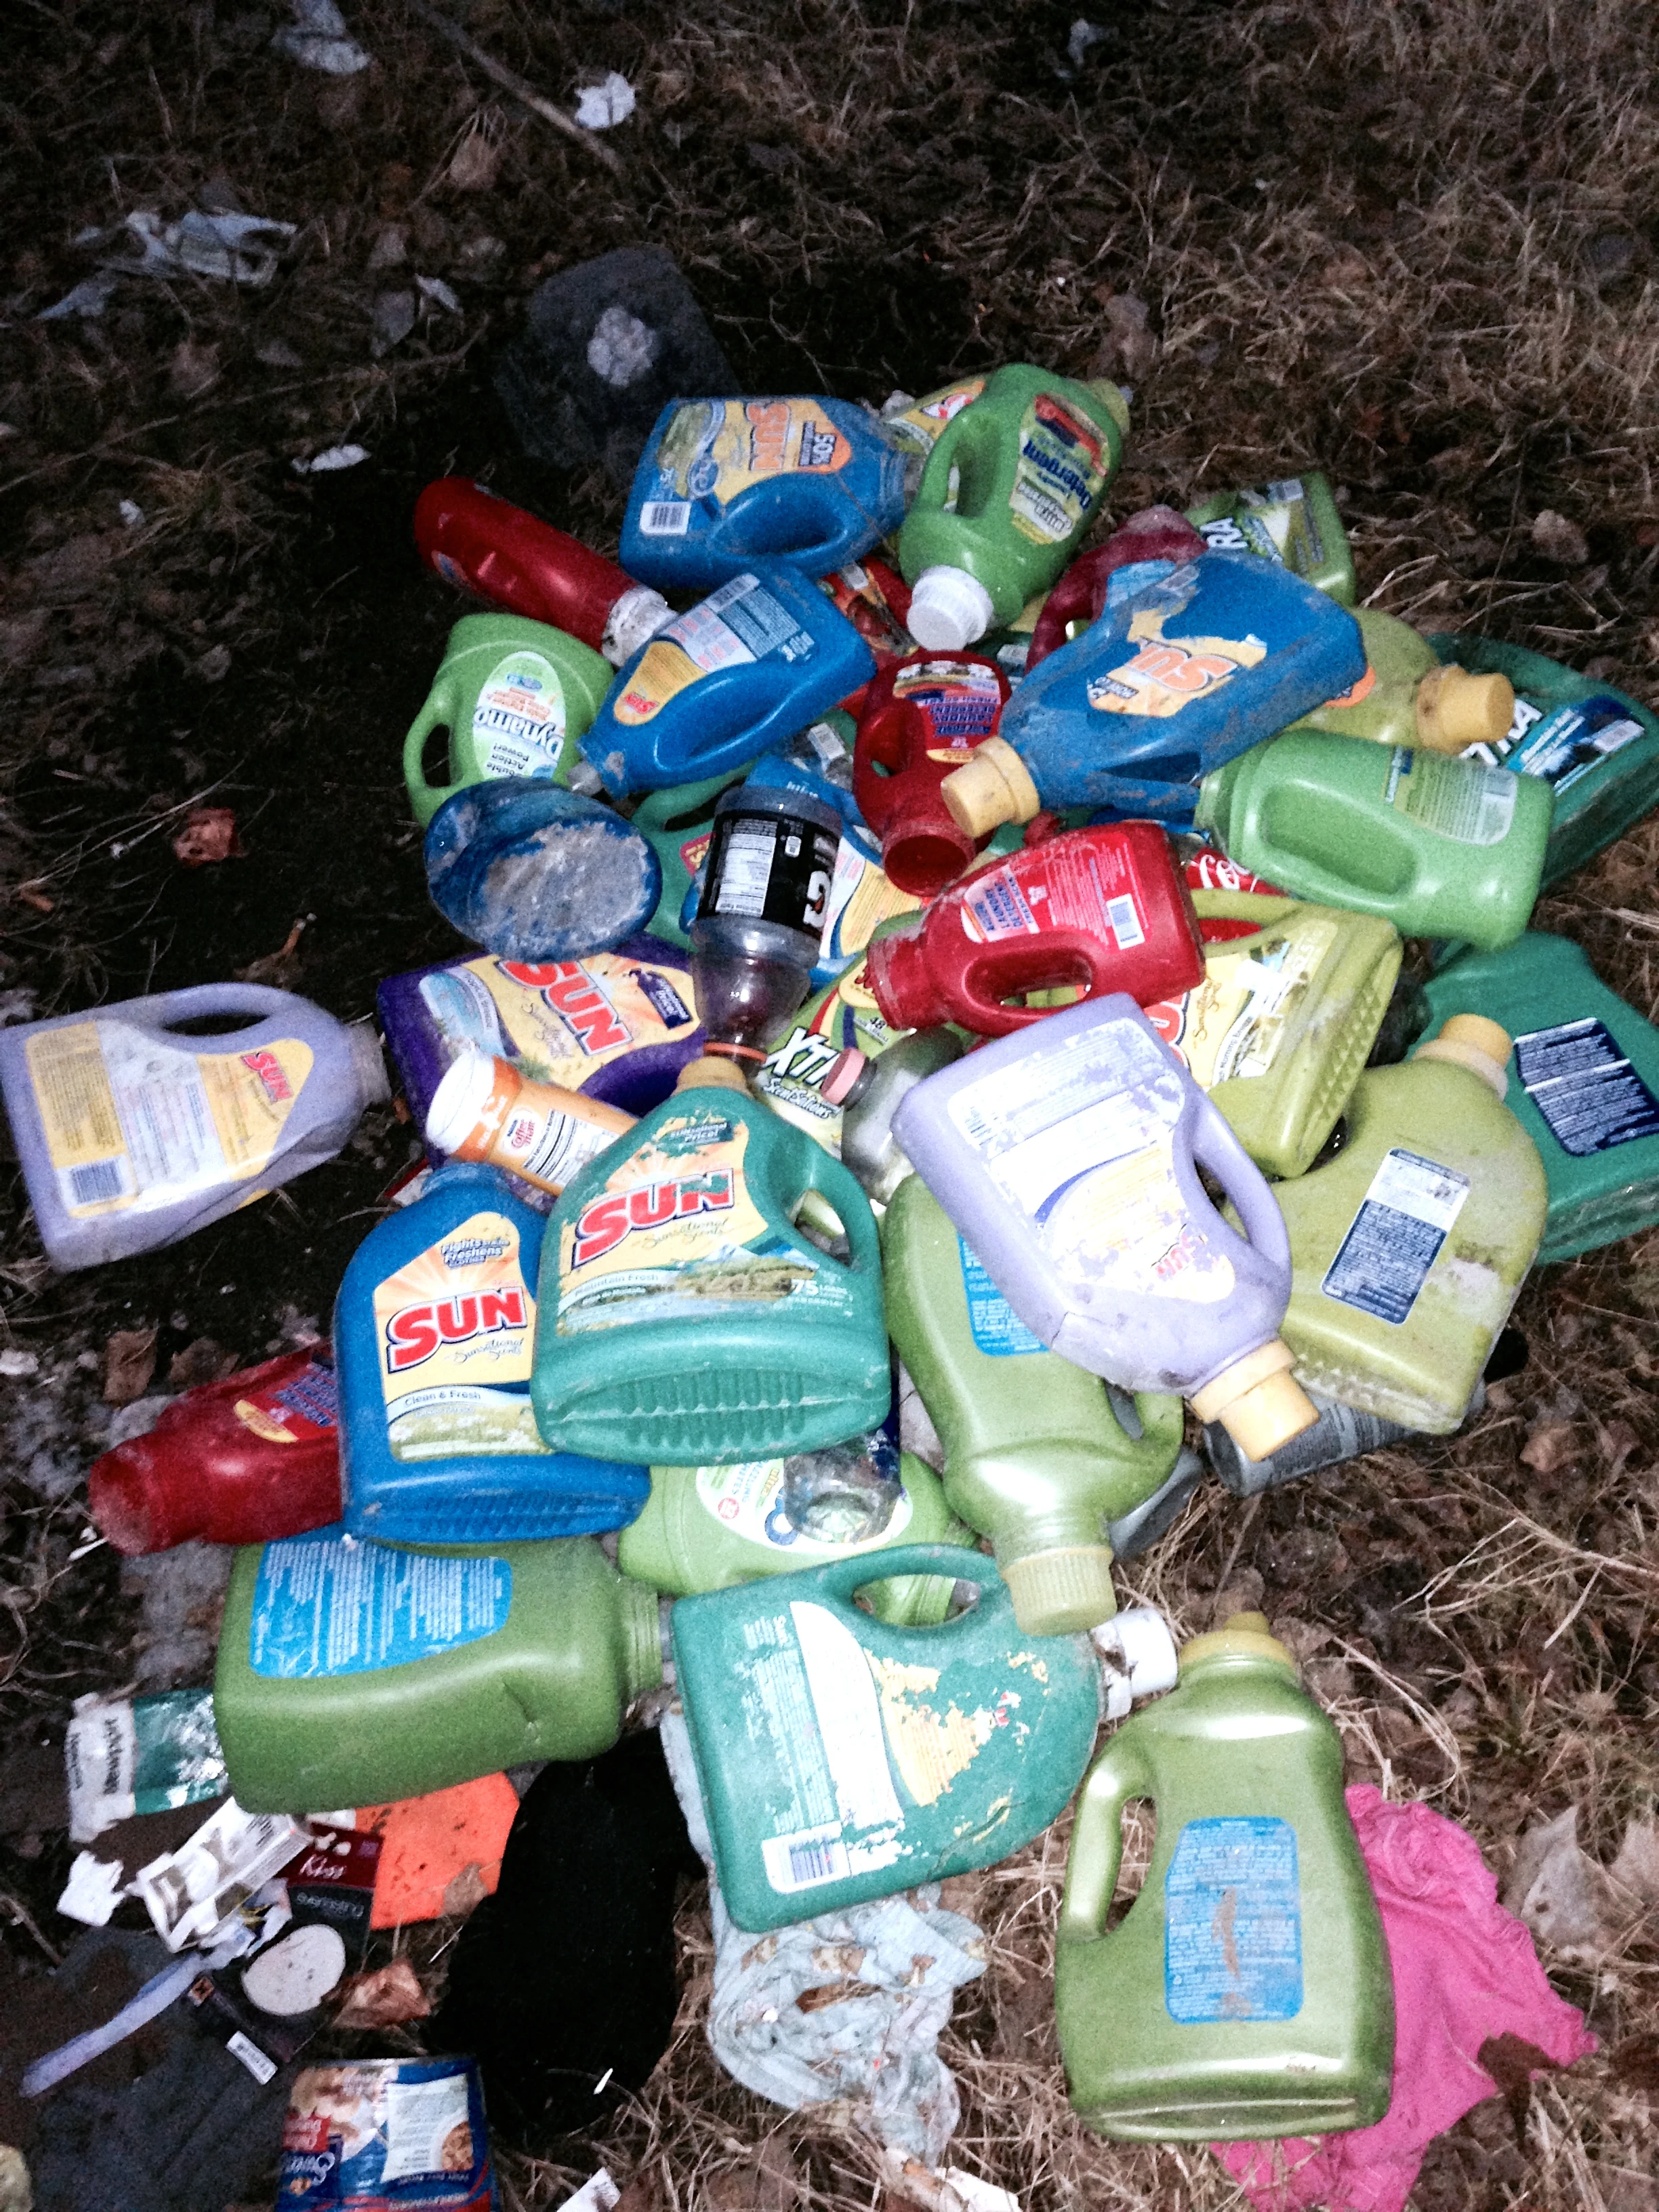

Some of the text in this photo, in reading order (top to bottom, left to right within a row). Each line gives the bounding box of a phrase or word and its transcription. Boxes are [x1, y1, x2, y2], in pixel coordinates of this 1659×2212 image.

[743, 403, 791, 471] SUN
[811, 433, 835, 464] 50%
[1021, 440, 1092, 510] Detergent
[1200, 516, 1248, 547] RA
[472, 705, 565, 762] Dynamo
[491, 753, 525, 770] Action
[492, 742, 530, 761] Power!
[486, 762, 515, 776] ouble
[983, 888, 1010, 929] LAUNDRY
[993, 882, 1023, 928] DETERGENT
[493, 958, 633, 1057] SUN
[762, 1026, 840, 1085] XT
[1217, 1038, 1238, 1069] Morning
[240, 1050, 295, 1103] SUN
[510, 1118, 527, 1149] Coffee
[571, 1166, 735, 1269] SUN
[441, 1240, 482, 1254] Fights
[444, 1246, 501, 1263] Freshens
[790, 1278, 819, 1296] 75
[386, 1286, 528, 1374] SUN
[453, 1337, 524, 1364] Sunsational
[405, 1390, 480, 1406] Clean & Fresh
[731, 1464, 748, 1496] HITES
[741, 1461, 763, 1503] AZZLING
